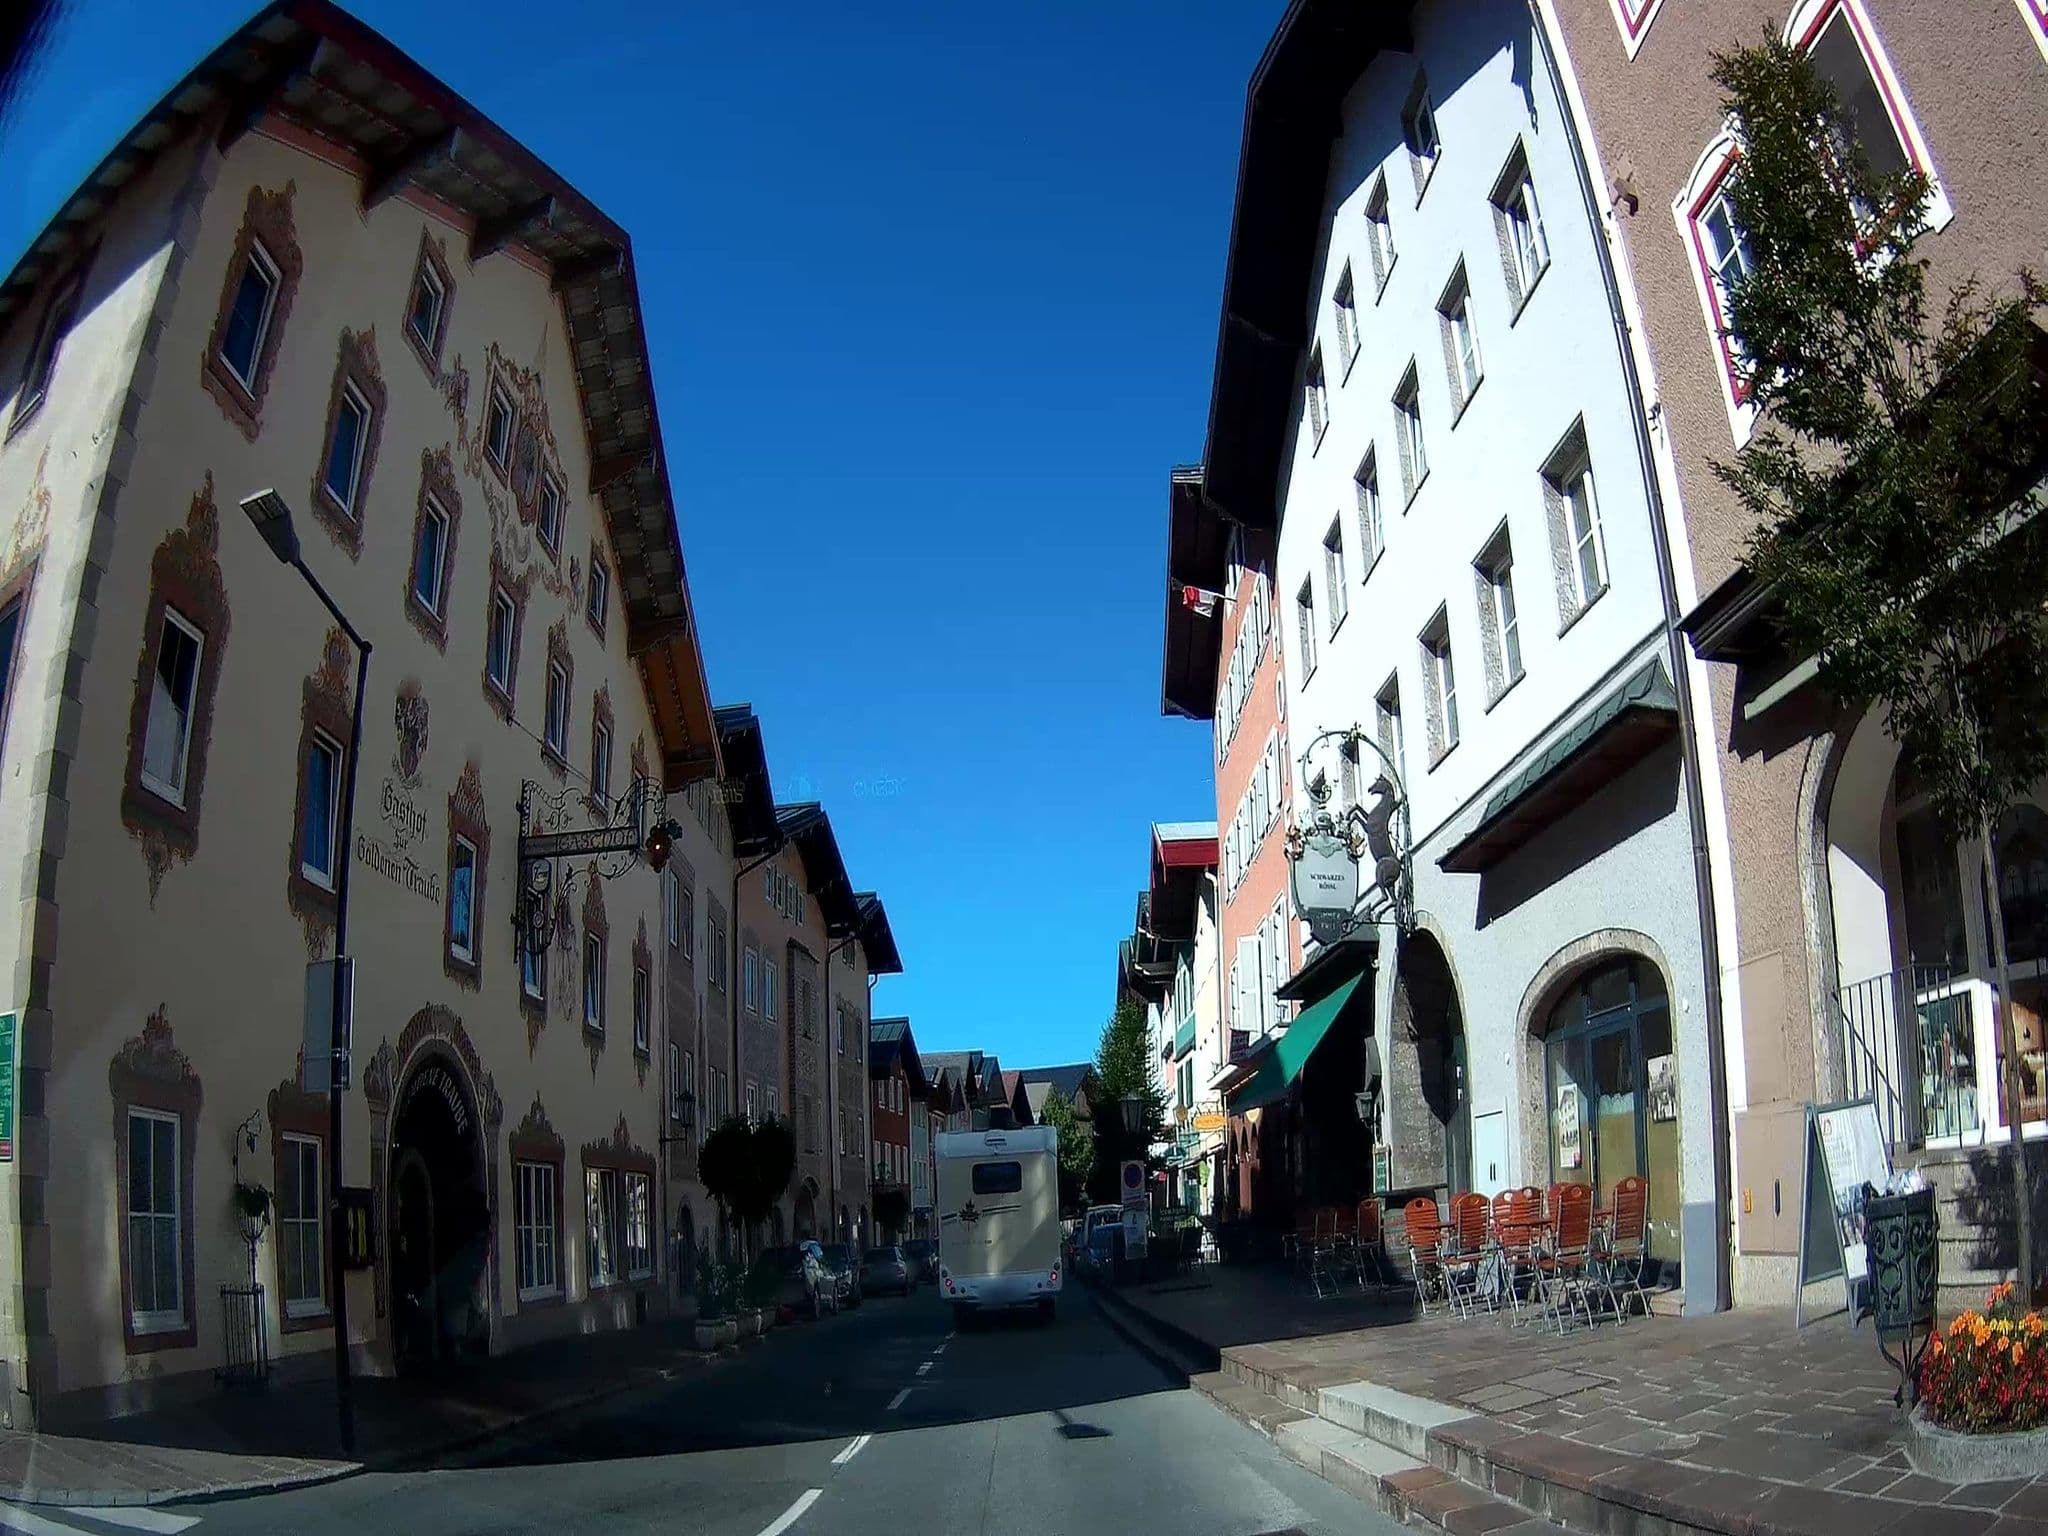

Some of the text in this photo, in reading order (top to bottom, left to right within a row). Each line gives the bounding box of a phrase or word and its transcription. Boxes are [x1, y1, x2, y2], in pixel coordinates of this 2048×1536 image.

[380, 782, 428, 842] Gasthof
[357, 834, 440, 904] Goldenen Traube
[438, 1070, 469, 1136] TRAUBE
